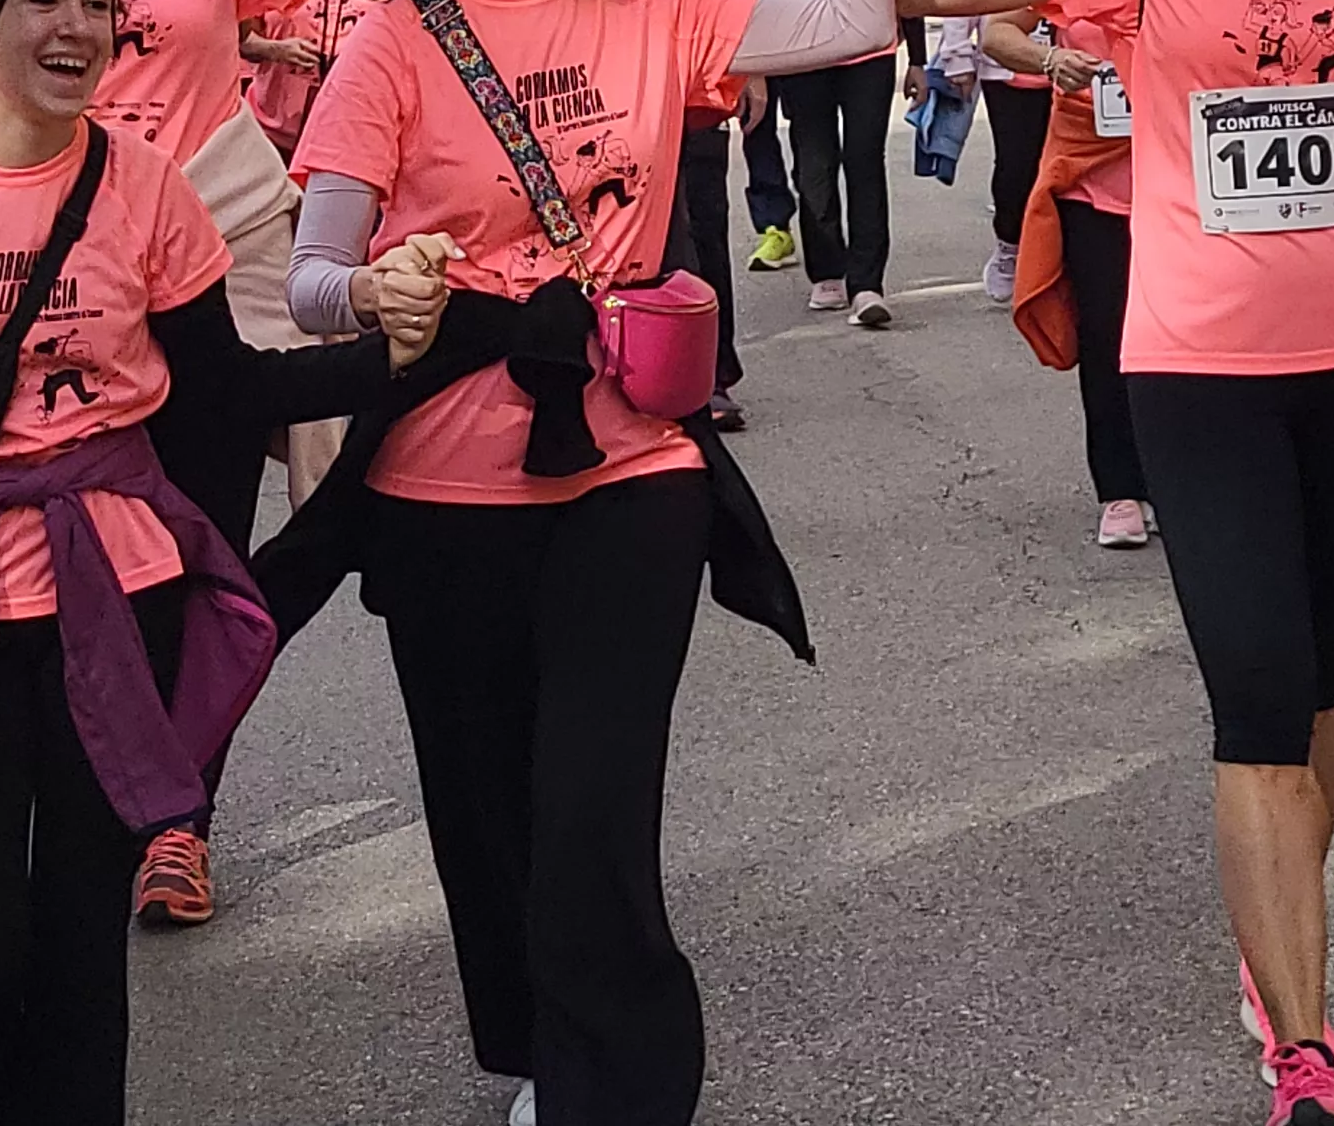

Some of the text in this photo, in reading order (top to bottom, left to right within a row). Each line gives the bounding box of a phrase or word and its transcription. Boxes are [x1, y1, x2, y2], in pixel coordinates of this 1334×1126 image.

[535, 99, 550, 129] LA
[552, 87, 605, 124] CIENCIA
[1268, 102, 1315, 113] HUESCA
[1216, 115, 1282, 131] CONTRA
[1285, 115, 1303, 127] EL
